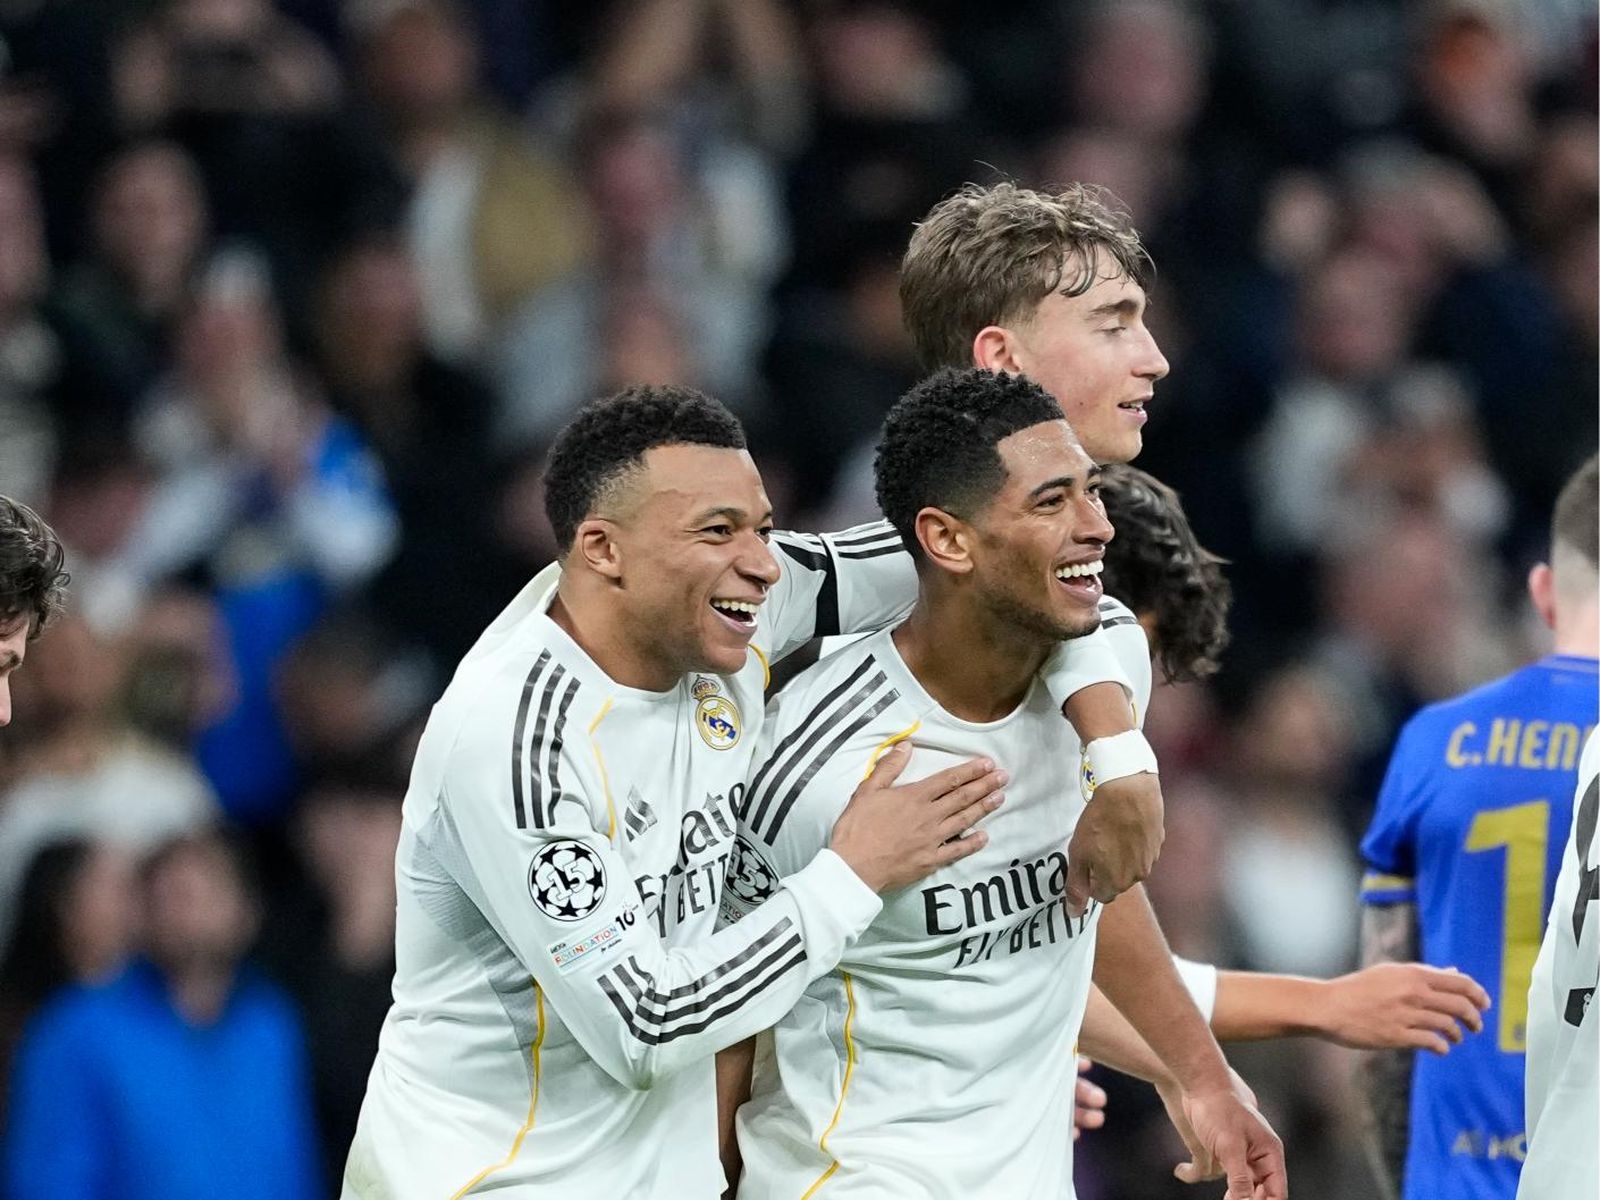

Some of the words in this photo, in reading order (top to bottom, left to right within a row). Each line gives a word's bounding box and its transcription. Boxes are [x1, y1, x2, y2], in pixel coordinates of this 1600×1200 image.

[1446, 717, 1595, 772] C.HEN
[546, 860, 587, 901] 15
[920, 851, 1068, 936] Emira
